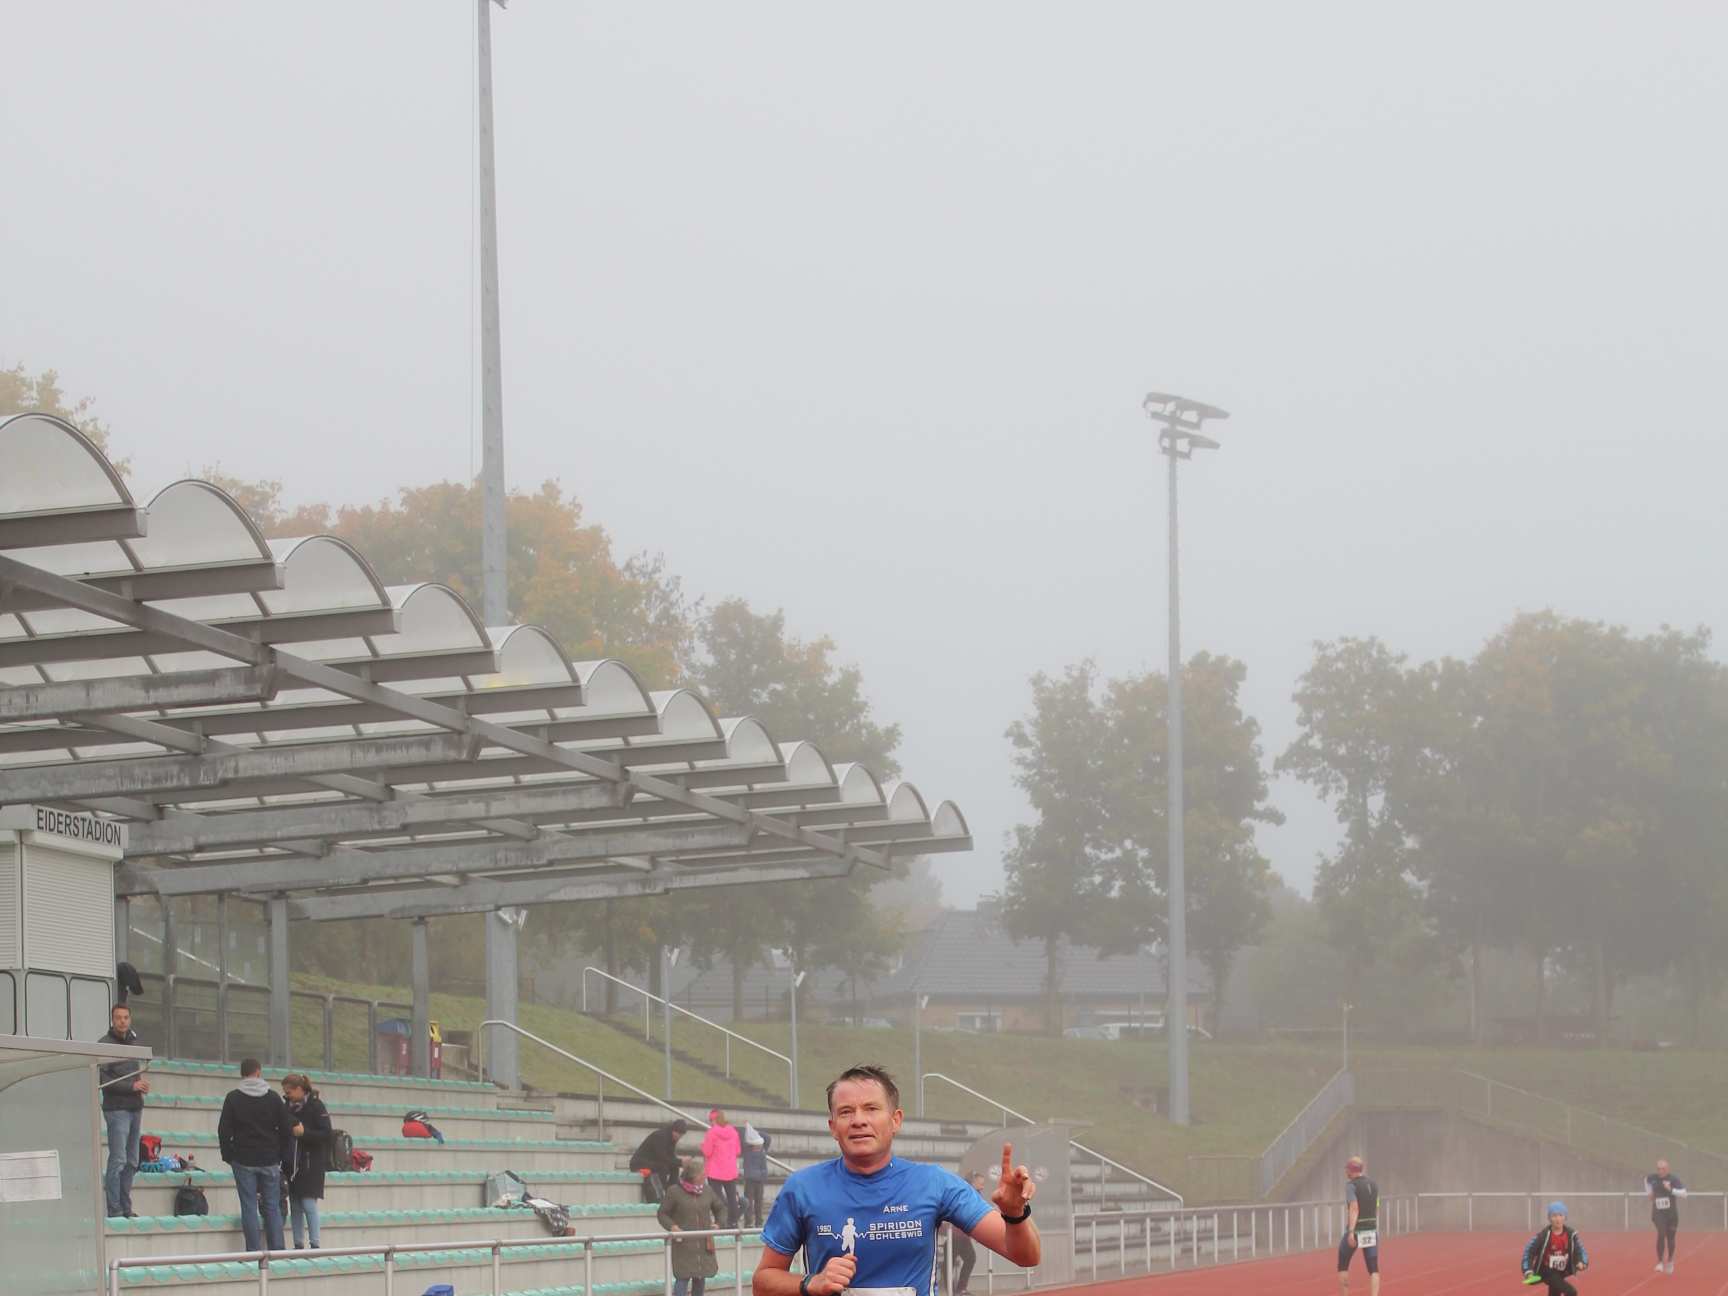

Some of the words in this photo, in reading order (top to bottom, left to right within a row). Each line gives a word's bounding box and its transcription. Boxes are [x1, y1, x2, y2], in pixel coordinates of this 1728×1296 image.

[36, 808, 121, 846] EIDERSTADION
[883, 1205, 909, 1214] ARNE
[869, 1220, 922, 1231] SPIRIDON
[869, 1231, 923, 1241] SCHLESWIG
